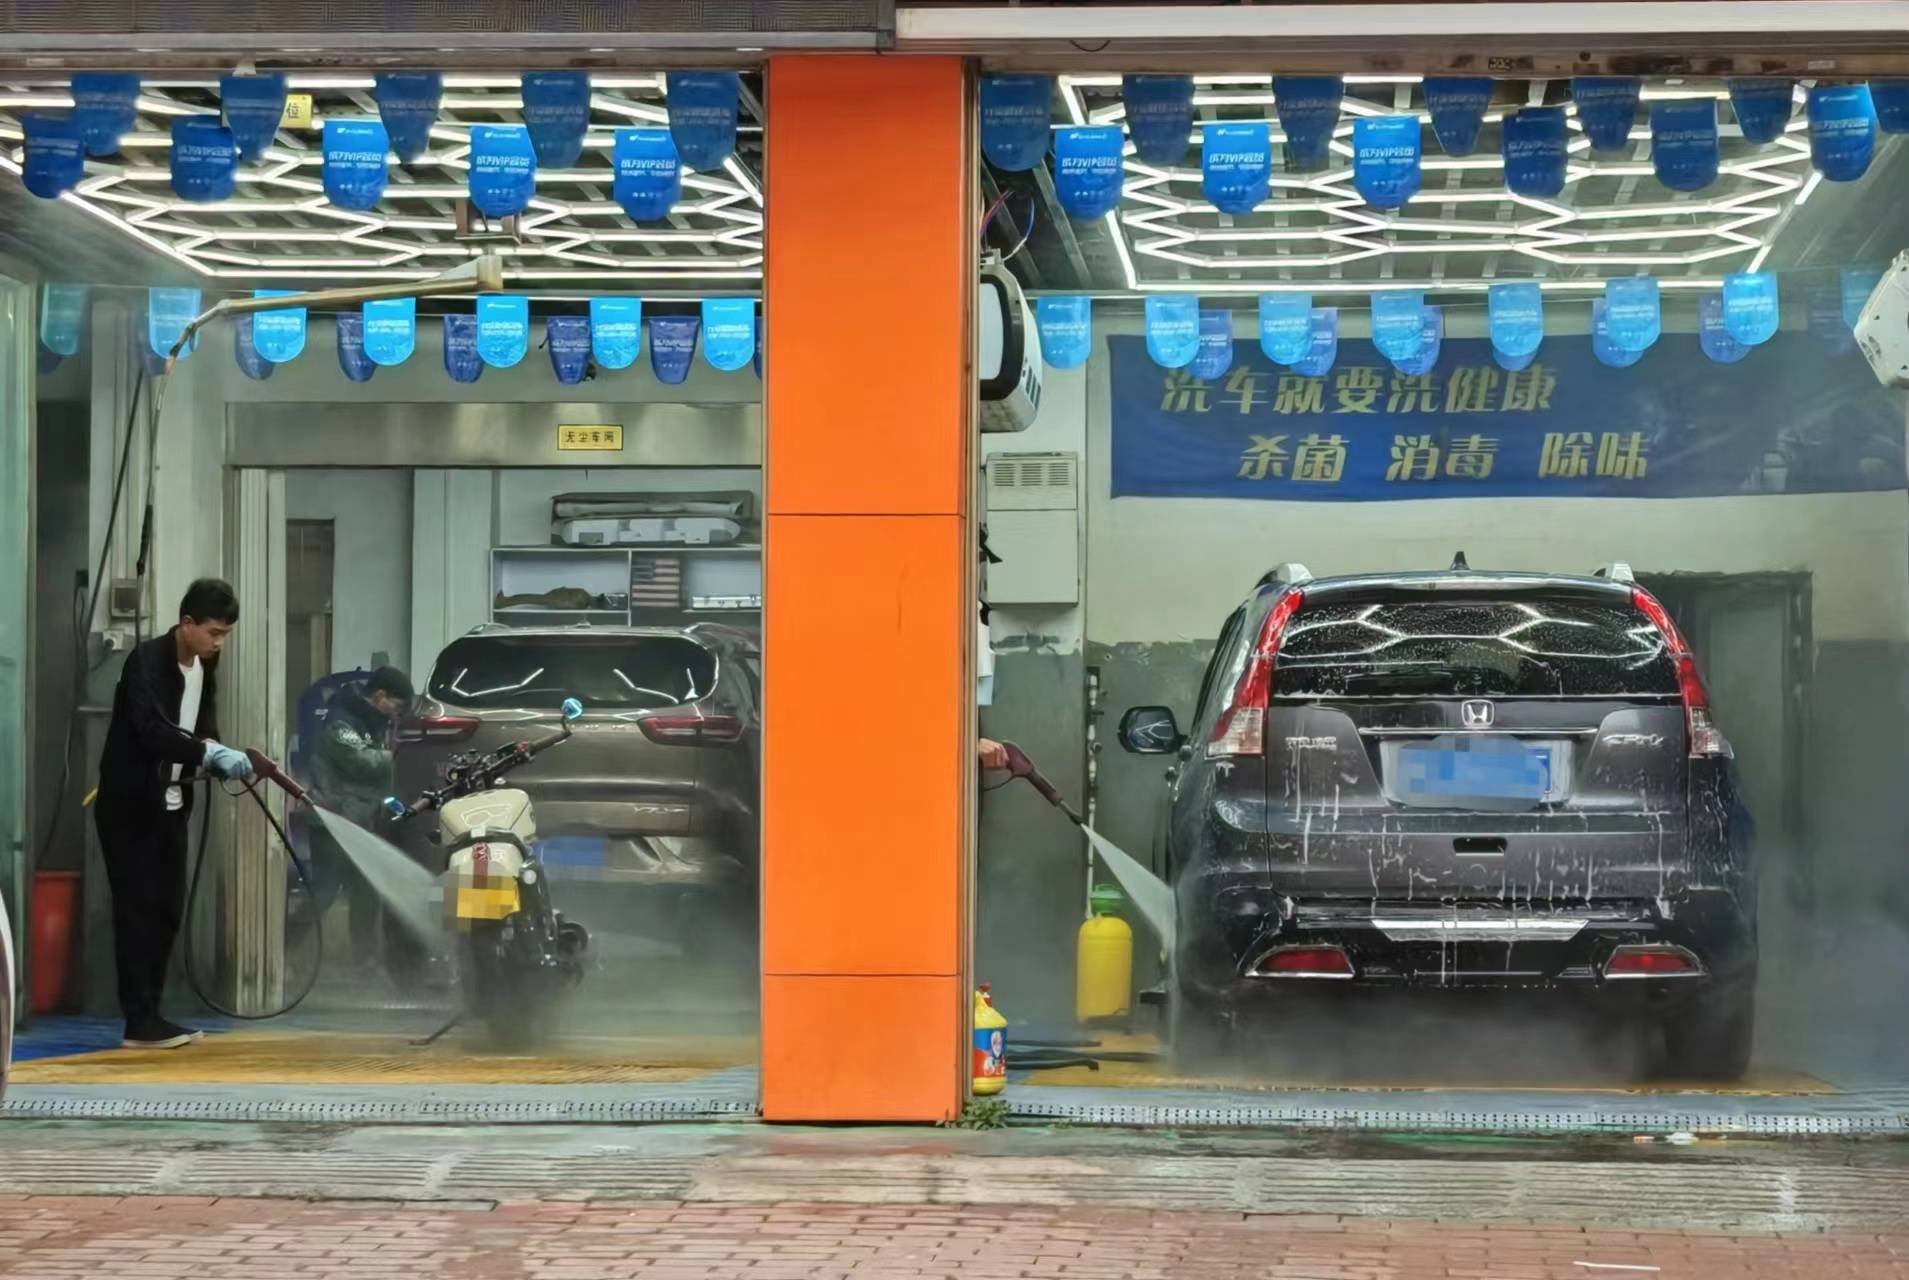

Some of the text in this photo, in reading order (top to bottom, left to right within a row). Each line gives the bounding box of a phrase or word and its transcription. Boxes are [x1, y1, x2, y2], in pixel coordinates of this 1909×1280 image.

[1160, 364, 1557, 414] 洗车就要洗健康
[1236, 431, 1650, 481] 杀菌 消毒 除味
